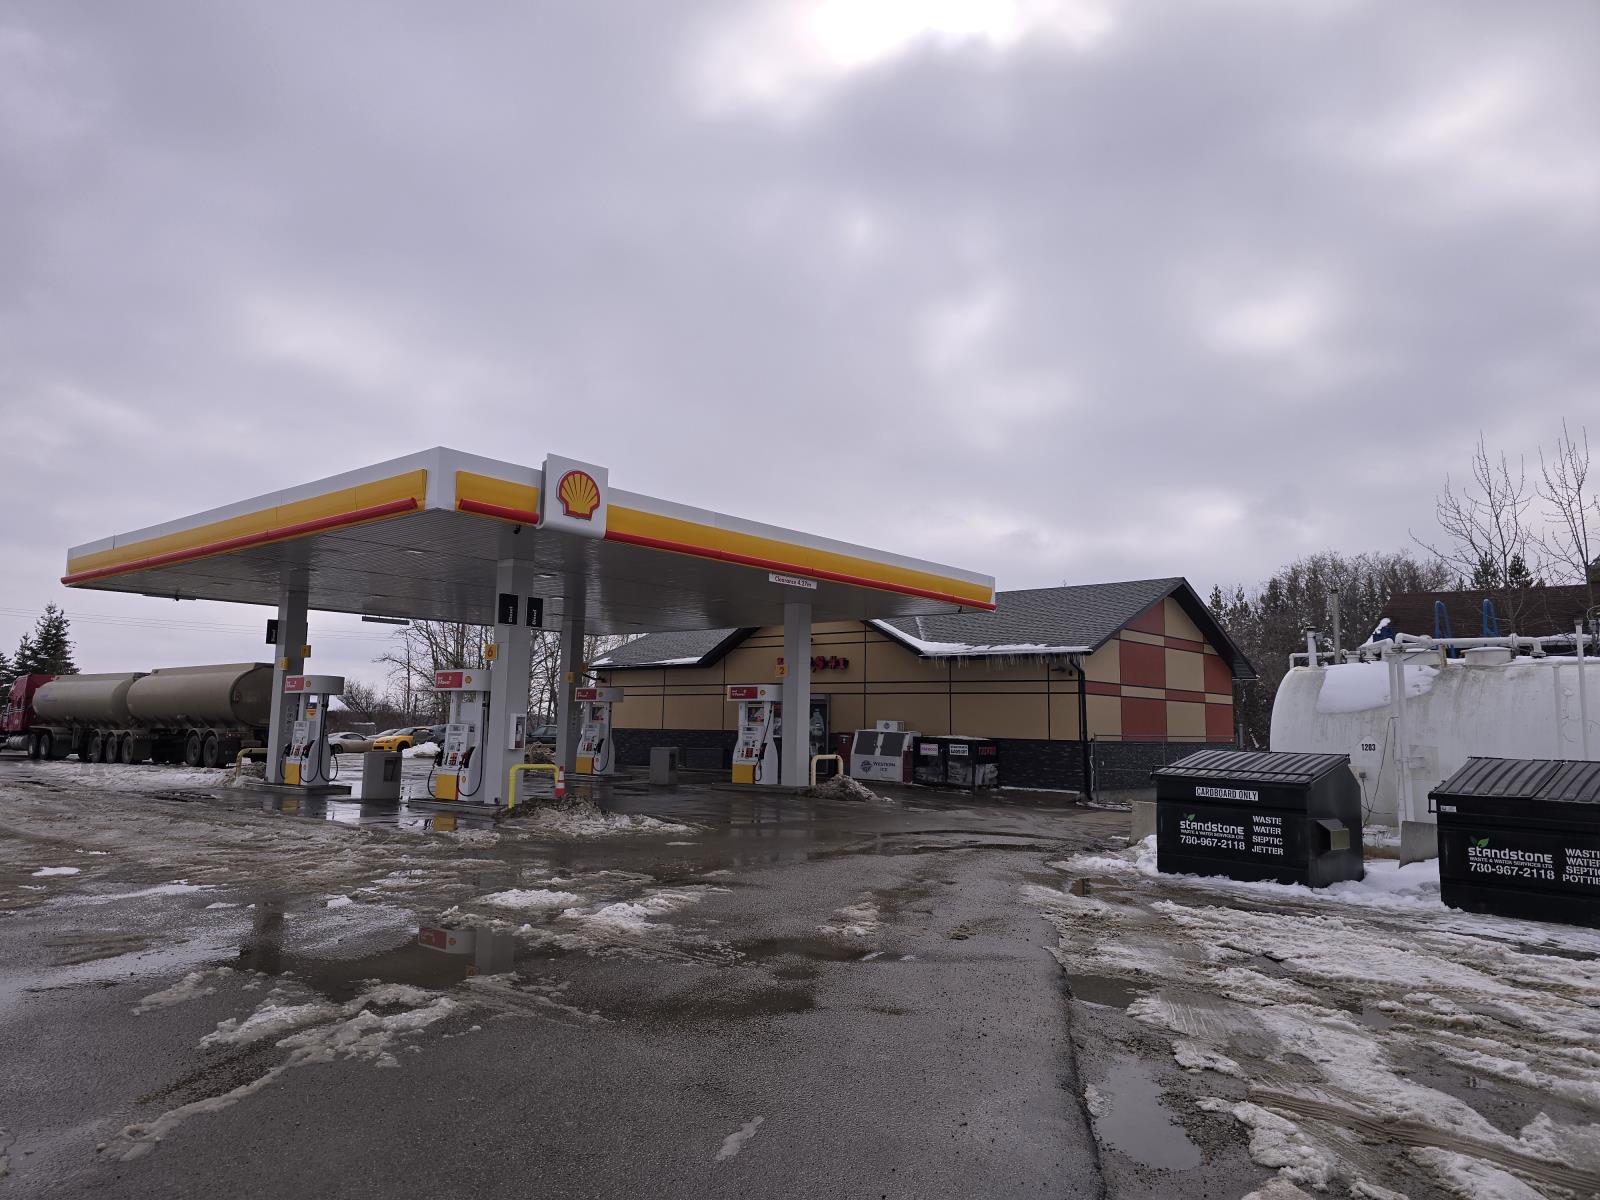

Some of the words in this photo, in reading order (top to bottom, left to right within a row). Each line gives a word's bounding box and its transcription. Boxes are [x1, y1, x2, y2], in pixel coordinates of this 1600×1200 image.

[775, 576, 796, 585] Clearance
[487, 646, 494, 657] 6
[1361, 743, 1376, 751] 1203
[1196, 787, 1237, 799] CARDBOARD
[1239, 790, 1257, 800] ONLY
[1252, 815, 1282, 825] WASTE
[1253, 825, 1282, 835] WATER
[1180, 835, 1246, 851] 780-967-2118
[1252, 835, 1283, 845] SEPTIC
[1251, 845, 1284, 856] JETTER
[1513, 860, 1541, 868] SERVICES
[1469, 862, 1555, 880] 780-967-2118
